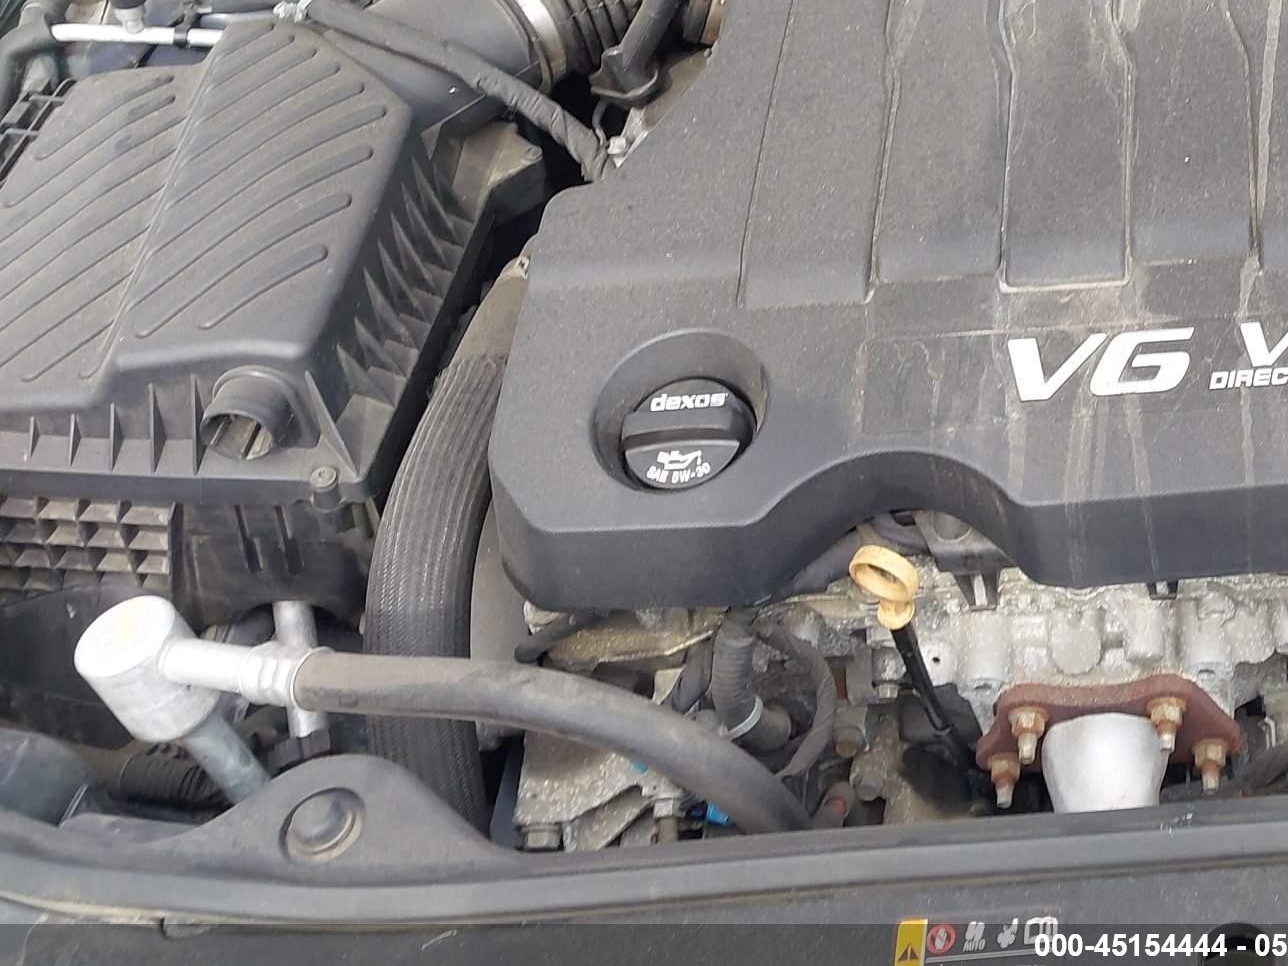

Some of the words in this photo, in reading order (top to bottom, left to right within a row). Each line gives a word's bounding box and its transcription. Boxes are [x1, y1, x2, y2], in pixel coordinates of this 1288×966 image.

[1007, 326, 1195, 402] V6
[650, 393, 729, 412] dexos
[646, 465, 669, 484] SAE
[671, 462, 711, 484] 5W-30
